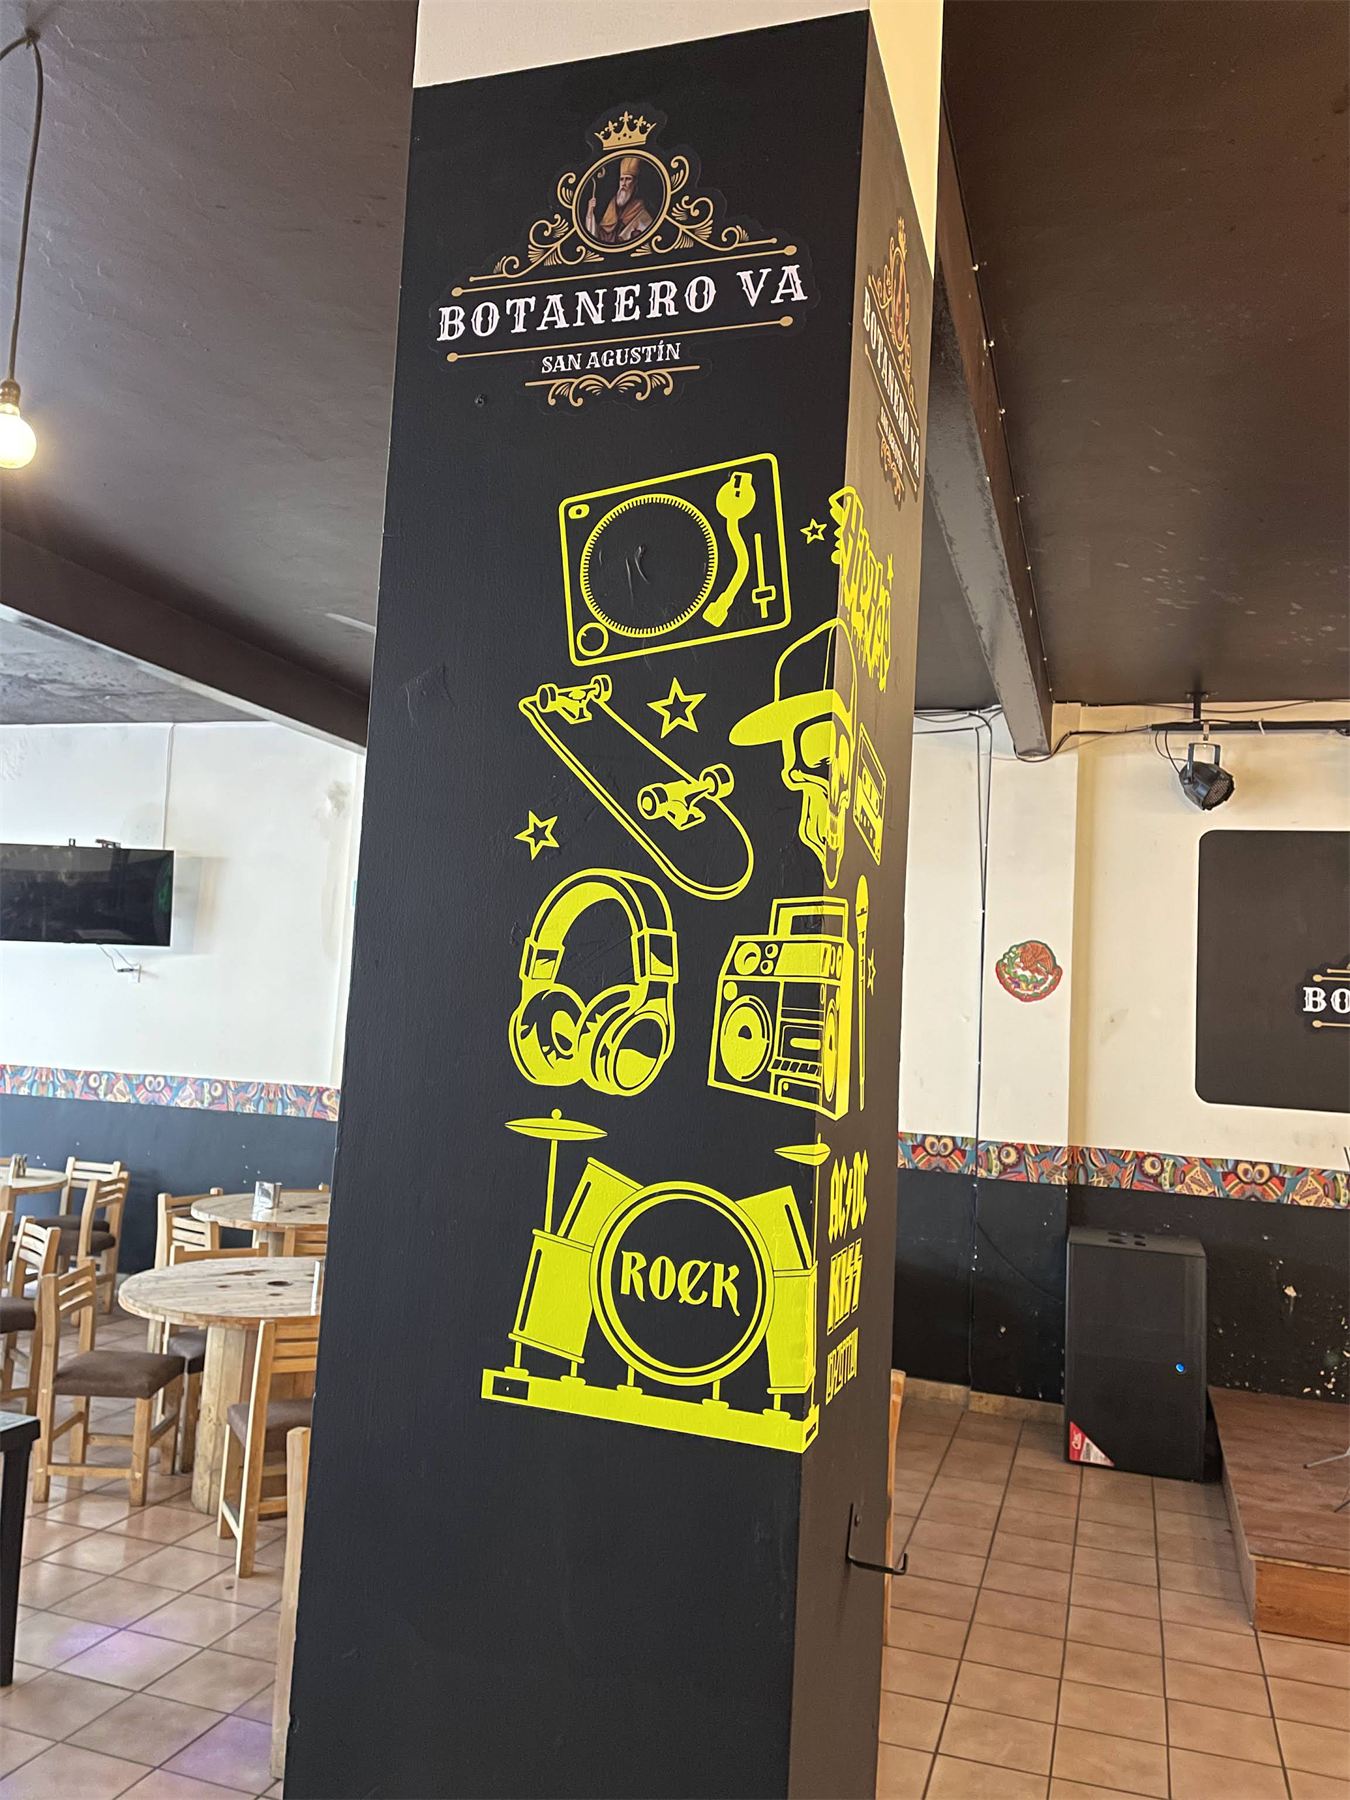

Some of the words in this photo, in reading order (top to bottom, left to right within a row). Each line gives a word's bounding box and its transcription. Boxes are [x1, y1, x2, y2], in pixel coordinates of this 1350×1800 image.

[436, 276, 717, 342] BOTANERO
[737, 265, 808, 307] VA
[541, 353, 581, 374] SAN
[586, 342, 681, 370] AGUSTÍN
[620, 1251, 740, 1317] ROCK
[827, 1239, 862, 1335] KISS
